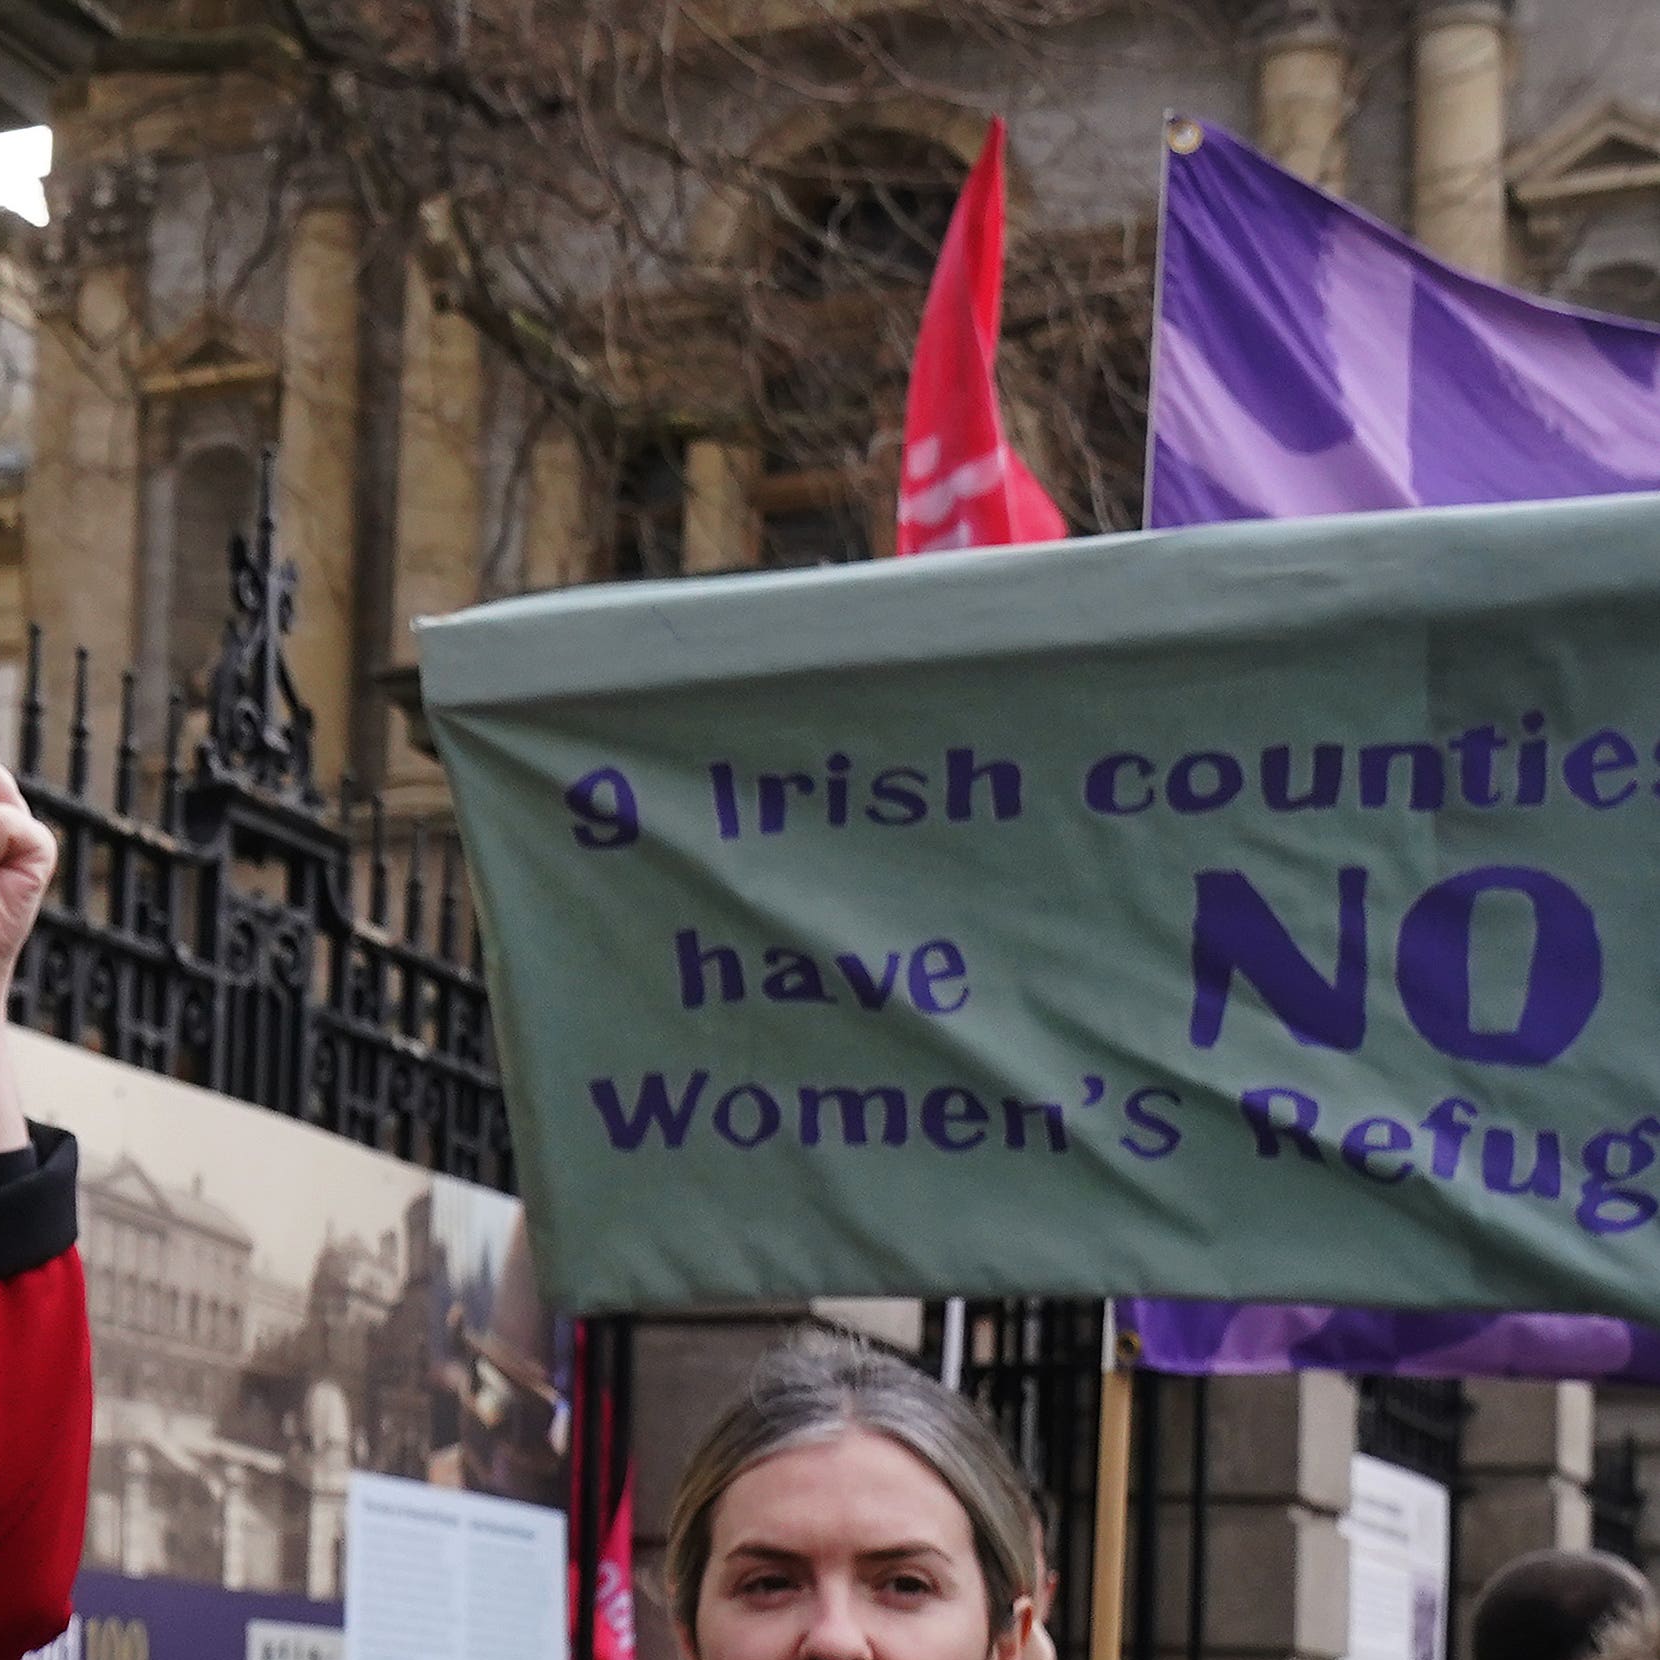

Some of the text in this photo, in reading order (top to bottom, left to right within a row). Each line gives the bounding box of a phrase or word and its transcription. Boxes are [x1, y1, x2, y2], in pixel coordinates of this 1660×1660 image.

[710, 748, 1023, 839] Irish
[1084, 710, 1660, 816] countie
[676, 865, 1605, 1069] have NO
[589, 1071, 1182, 1161] Women's
